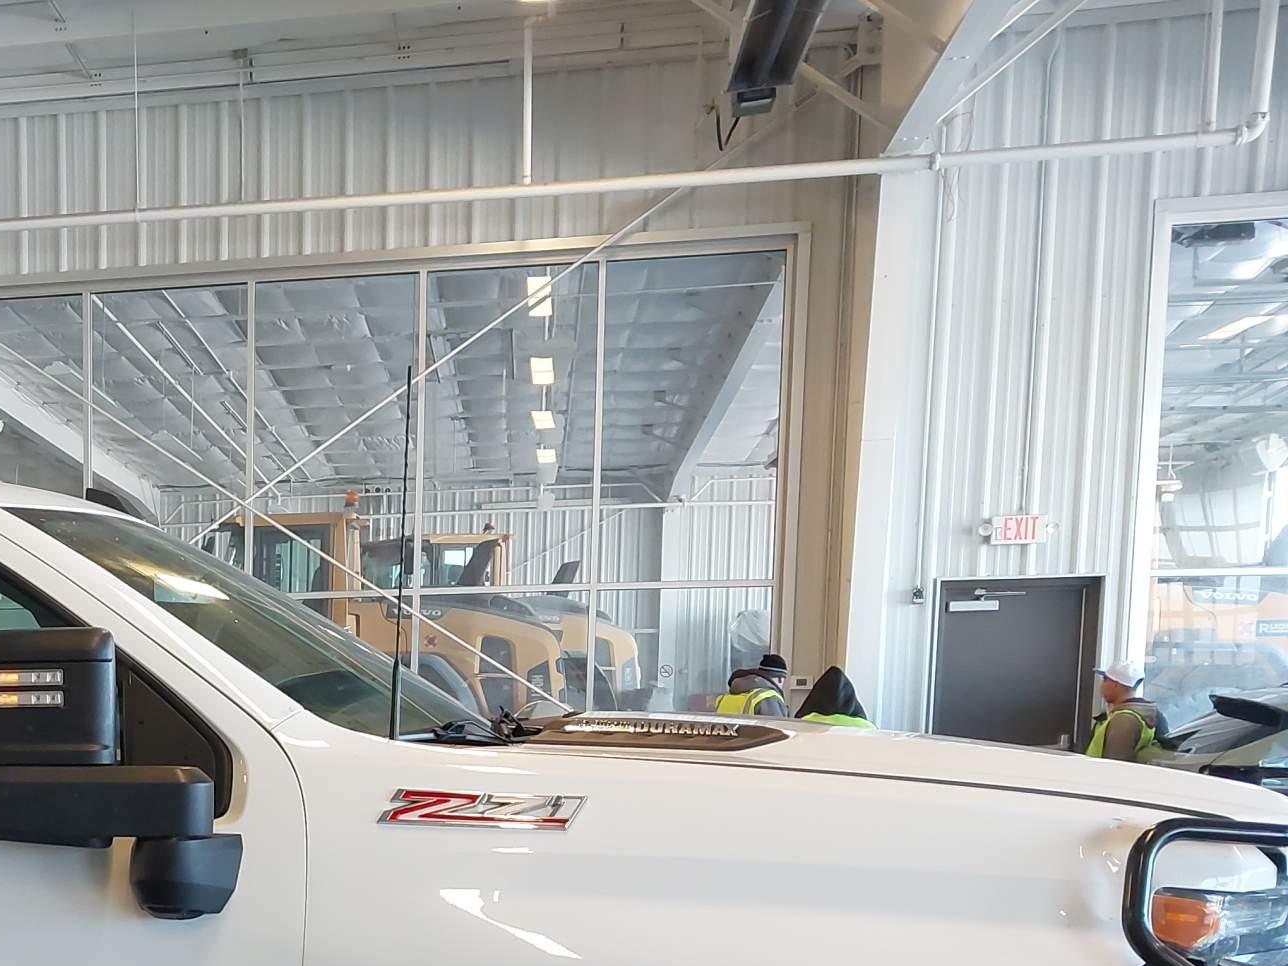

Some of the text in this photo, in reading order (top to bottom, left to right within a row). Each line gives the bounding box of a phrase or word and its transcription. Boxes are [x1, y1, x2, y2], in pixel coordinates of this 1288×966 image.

[1003, 516, 1040, 541] EXIT
[1198, 591, 1258, 601] VOLVO
[391, 608, 442, 616] VOVO
[636, 720, 740, 737] DURAMAX
[377, 787, 588, 832] Z71
